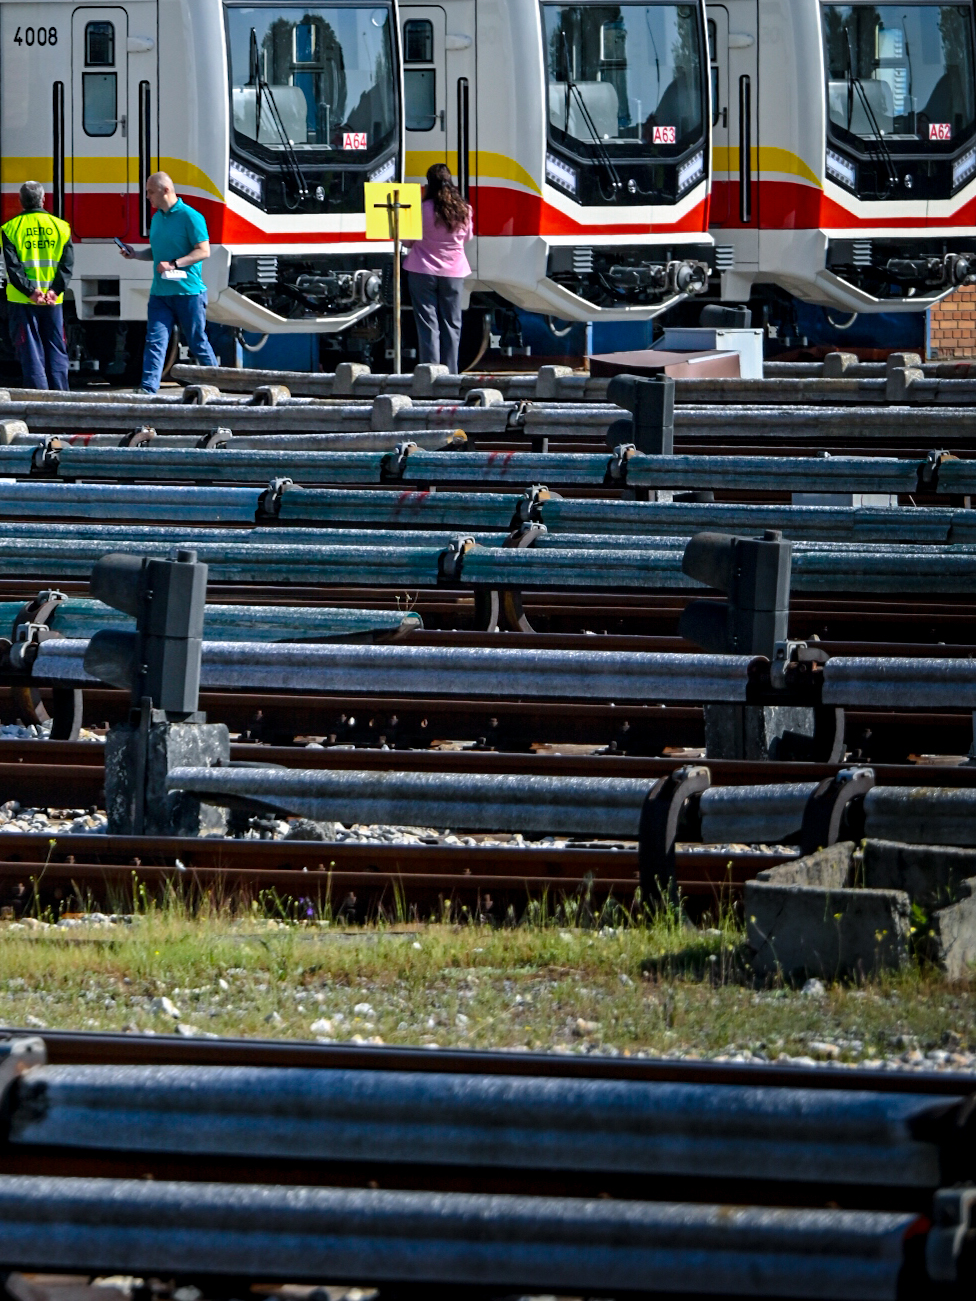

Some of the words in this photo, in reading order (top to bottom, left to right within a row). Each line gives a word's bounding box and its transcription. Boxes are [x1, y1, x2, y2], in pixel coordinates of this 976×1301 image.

[13, 26, 58, 47] 4008
[653, 126, 676, 143] A63
[929, 123, 951, 140] A62
[344, 132, 367, 150] A64
